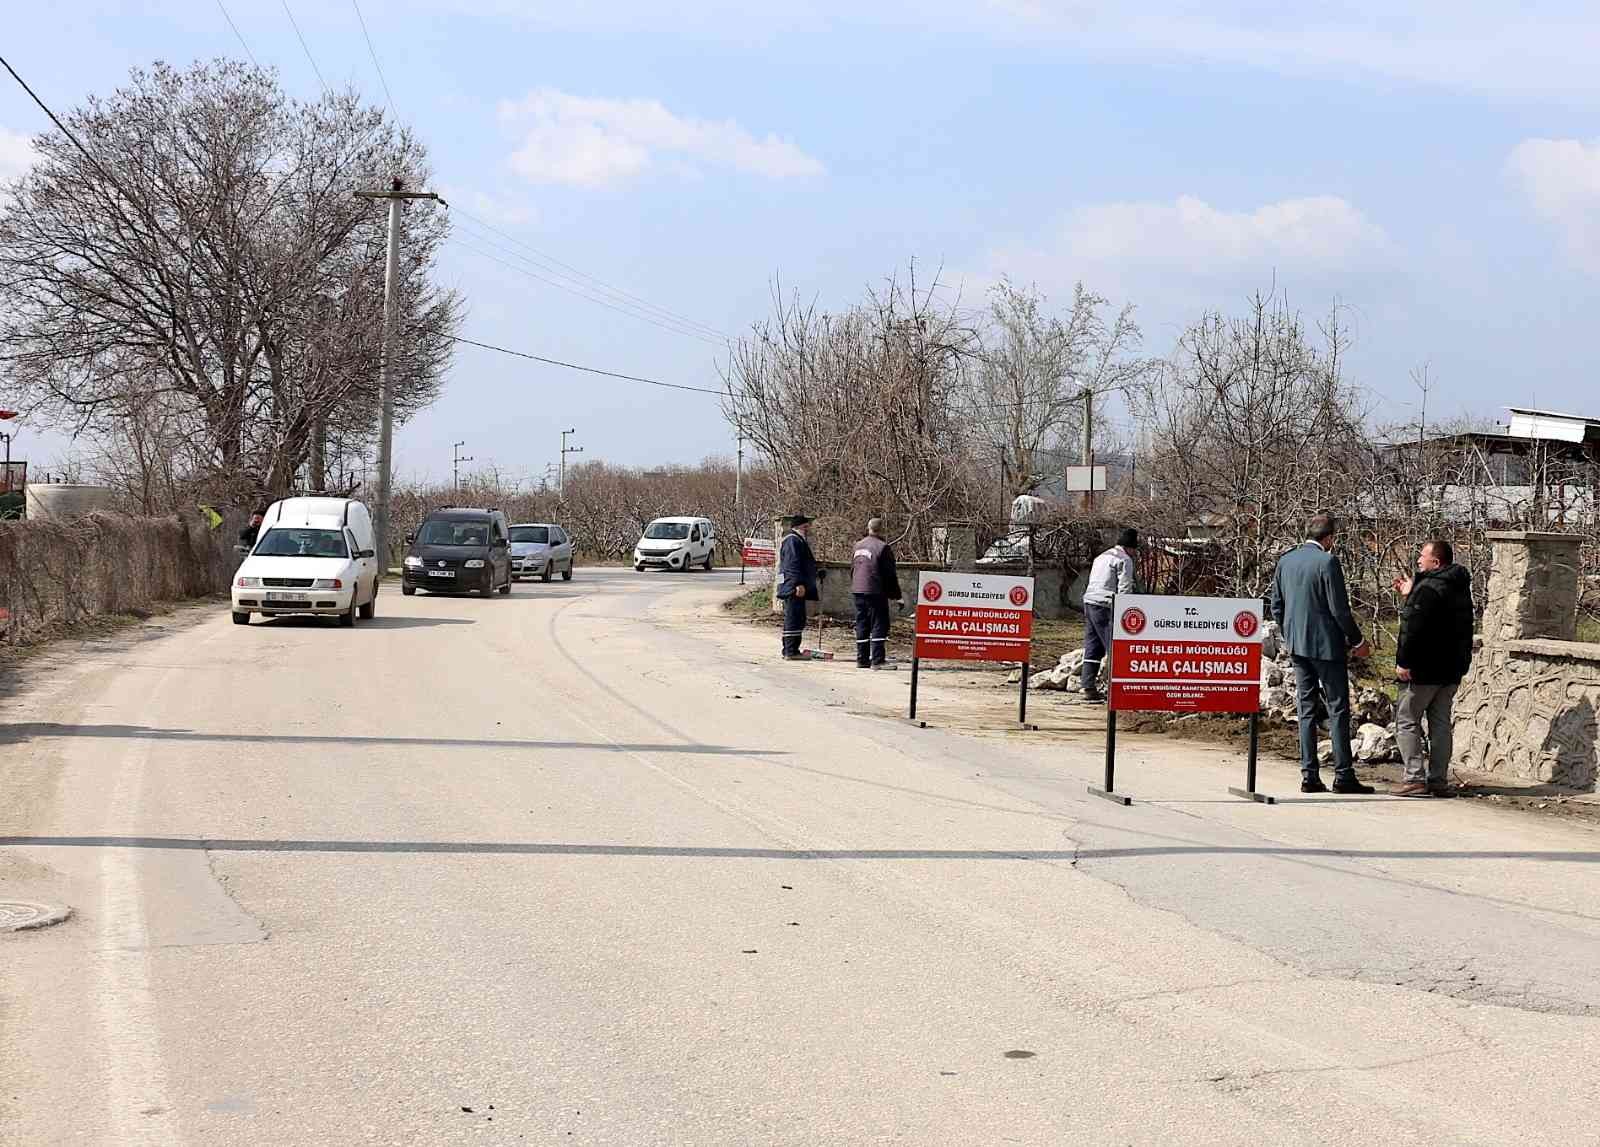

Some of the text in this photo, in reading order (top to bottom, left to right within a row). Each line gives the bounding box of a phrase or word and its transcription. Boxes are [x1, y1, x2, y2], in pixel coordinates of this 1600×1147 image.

[970, 591, 1006, 600] BELEDİYESİ
[946, 609, 970, 617] İŞLERİ
[972, 610, 1020, 619] MÜDÜRLÜĞÜ
[1184, 607, 1199, 616] T.C.
[929, 621, 1020, 635] SAHA ÇALIŞMASI
[1154, 619, 1181, 629] GÜRSU
[1183, 619, 1228, 630] BELEDİYESİ
[1129, 644, 1248, 656] FEN İŞLERİ MÜDÜRLÜĞÜ
[1130, 660, 1248, 677] SAHA ÇALIŞMASI
